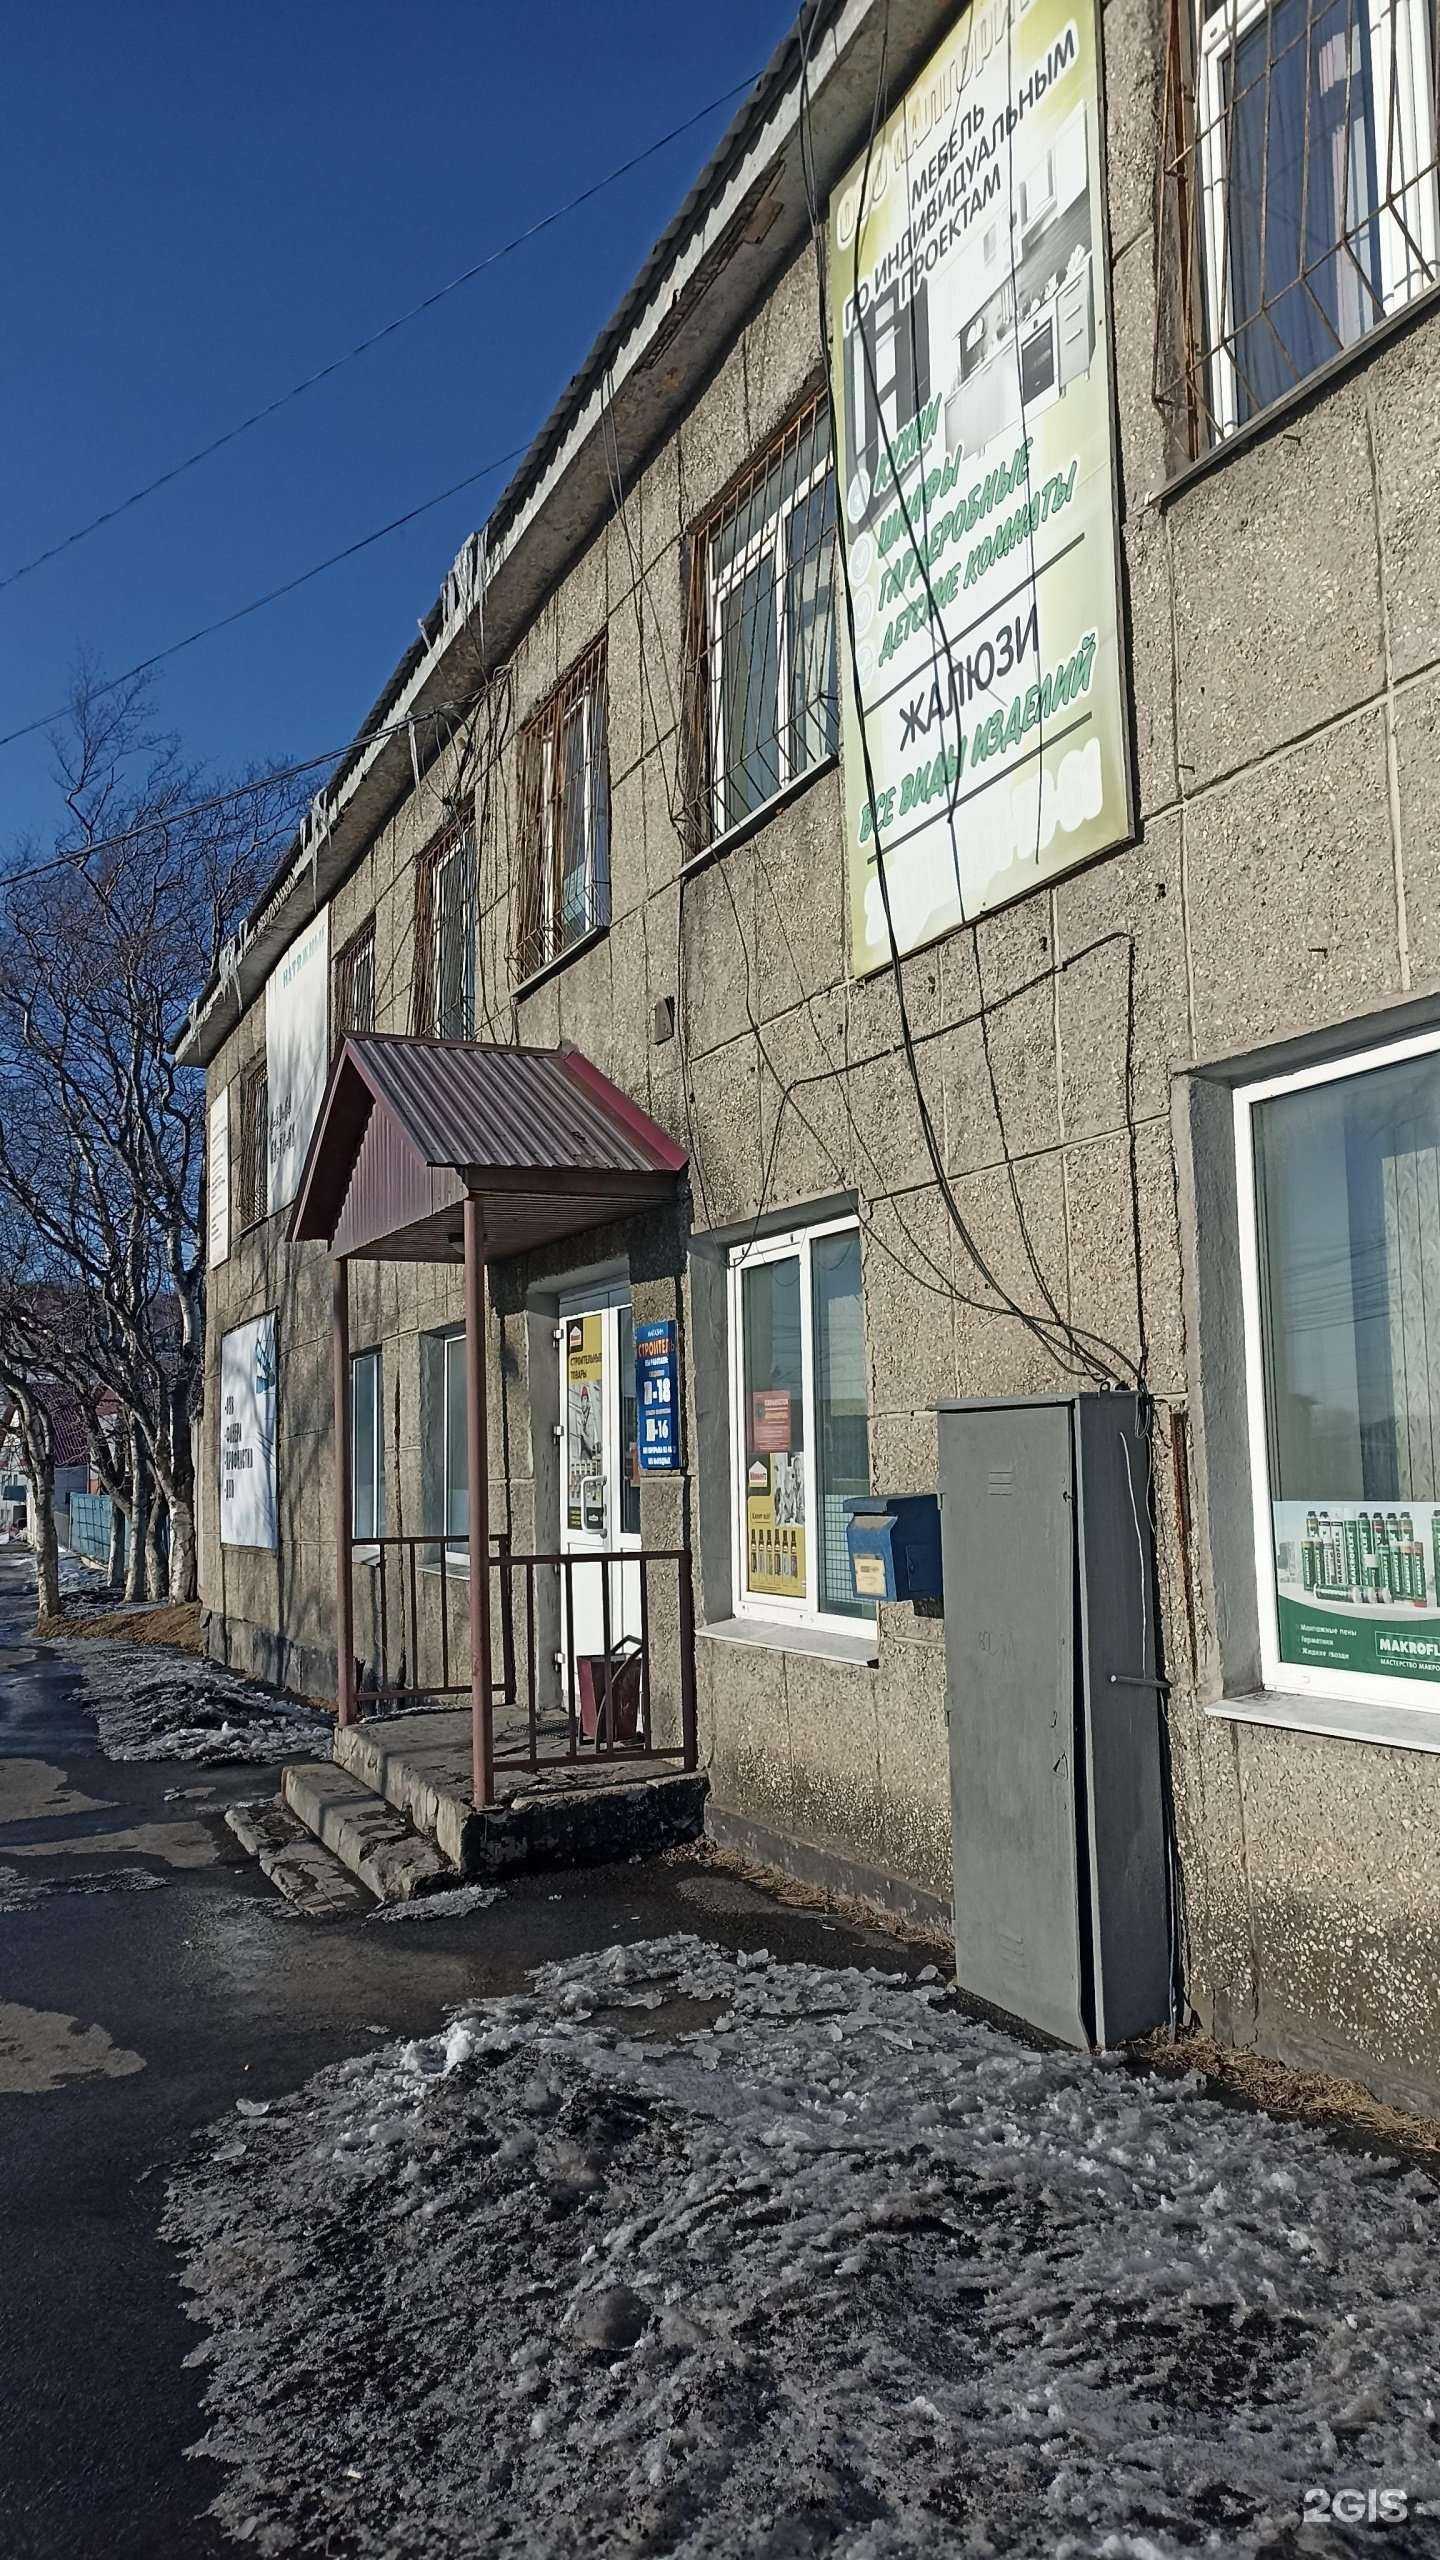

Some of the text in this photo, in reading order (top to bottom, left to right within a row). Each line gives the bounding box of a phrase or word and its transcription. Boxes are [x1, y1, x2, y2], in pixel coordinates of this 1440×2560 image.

[845, 29, 1076, 331] ПО ИНДИВИДУАЛЬНЫМ
[912, 104, 985, 210] МЕБЕЛЬ
[902, 163, 1001, 302] ПРОЕКТАМ
[874, 391, 943, 495] КУХНИ
[878, 444, 963, 559] ШКАФЫ
[878, 436, 1033, 612] ГАРДЕРОБНЫЕ
[878, 460, 1077, 668] ДЕТСКИЕ КОМНАТЫ
[859, 632, 1096, 843] ВСЕ ВИДЫ ИЗДЕЛИЙ
[900, 602, 1039, 752] ЖАЛЮЗИ
[1339, 1628, 1357, 1636] пены
[1379, 1638, 1440, 1657] MAKROFL
[1380, 1658, 1418, 1669] МАСТЕРСТВО
